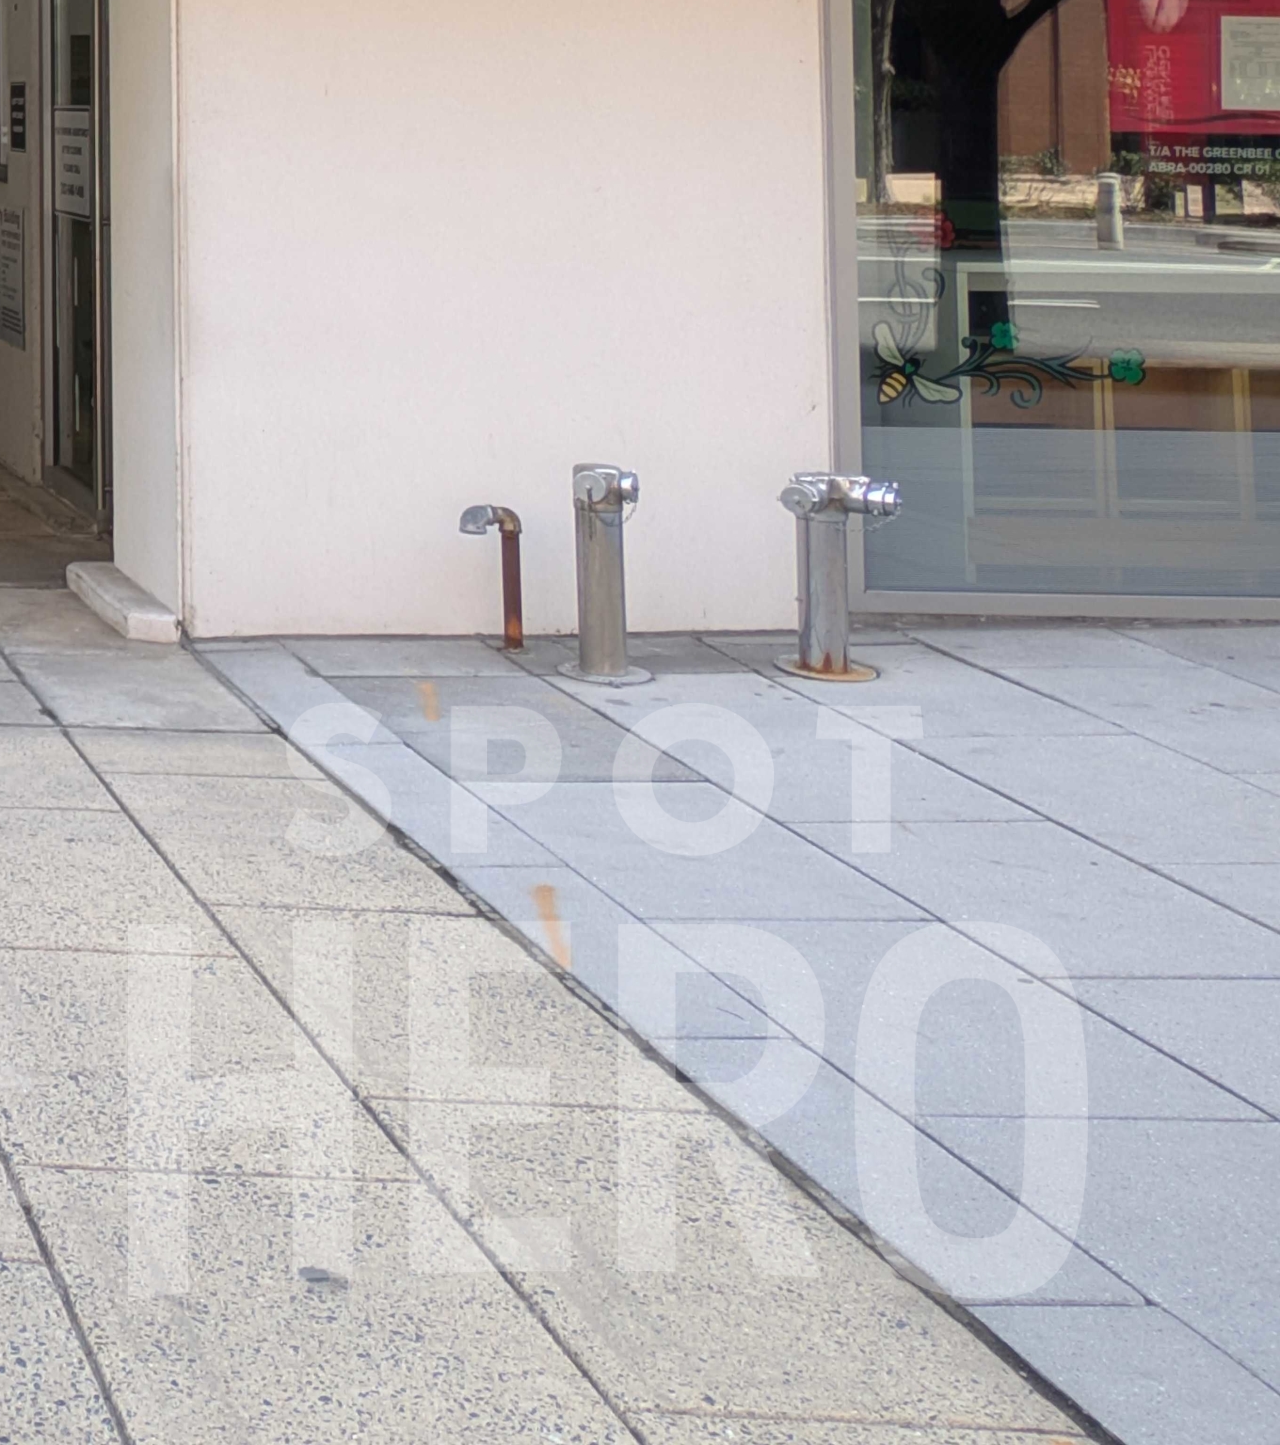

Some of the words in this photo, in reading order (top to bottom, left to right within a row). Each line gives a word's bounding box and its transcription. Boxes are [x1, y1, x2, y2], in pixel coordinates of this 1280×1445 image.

[1148, 146, 1171, 157] T/A
[1173, 146, 1200, 158] THE
[1203, 147, 1274, 159] GREENBEE
[1233, 163, 1252, 174] CR
[1255, 163, 1271, 174] 01
